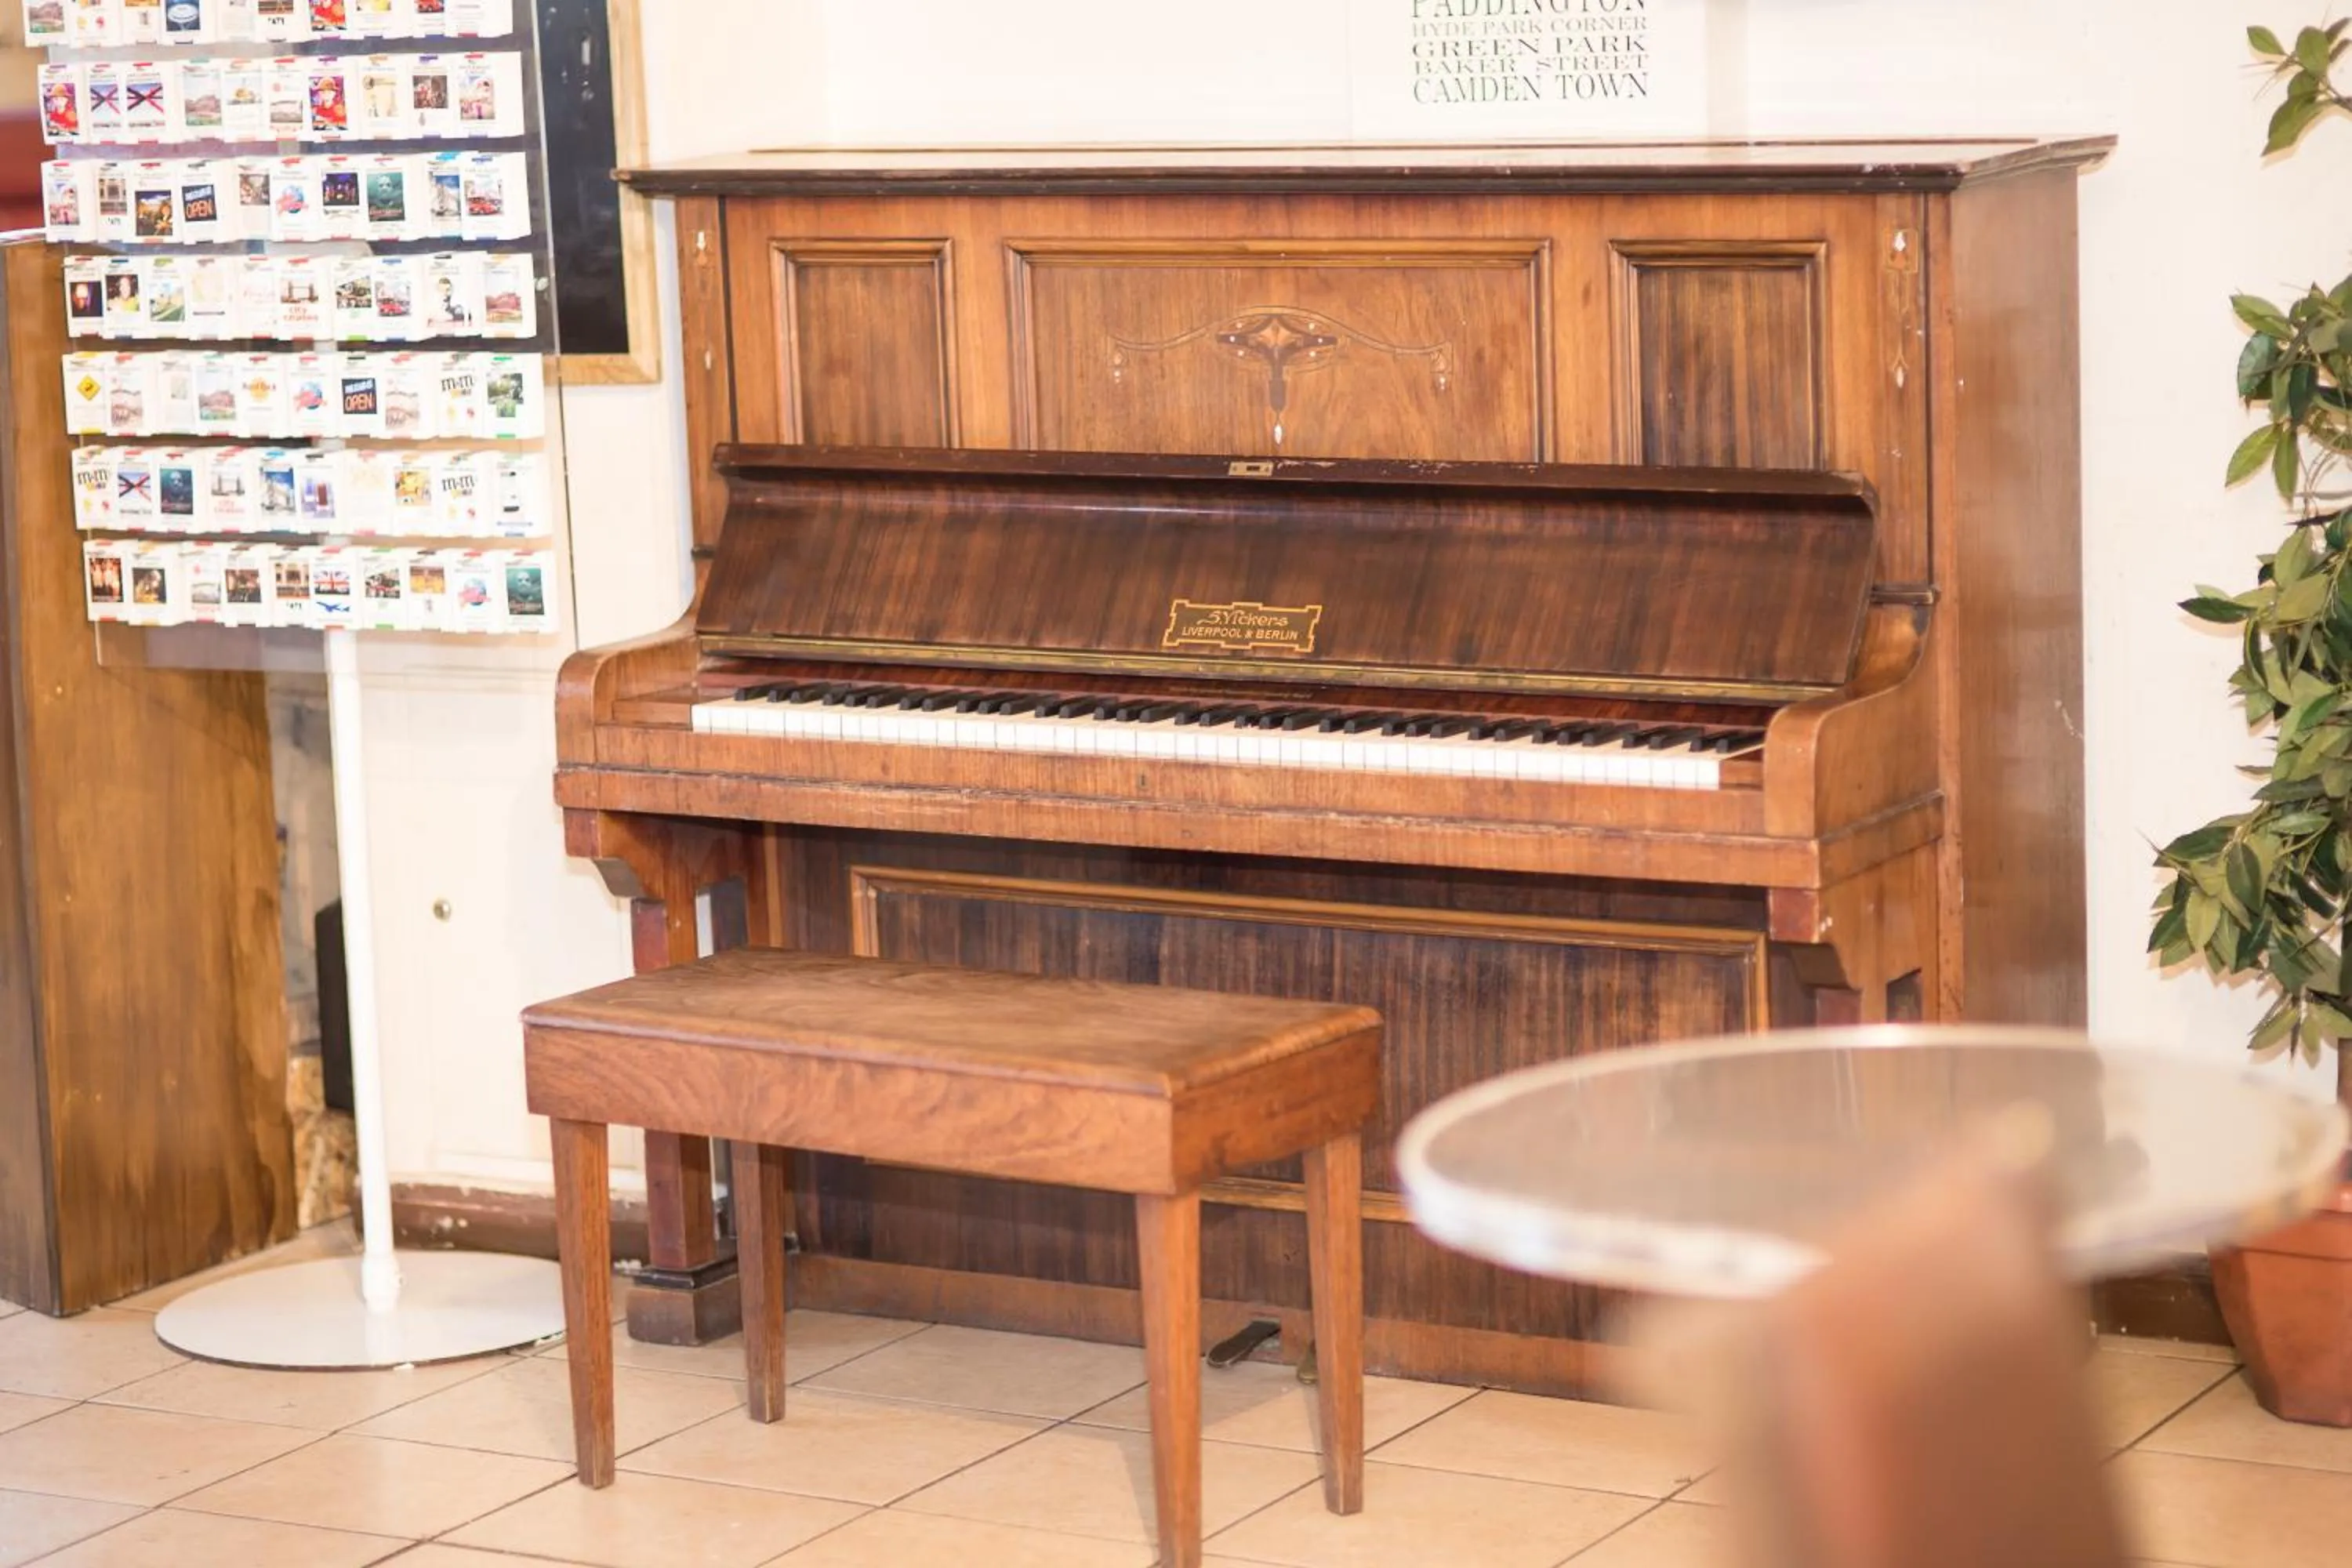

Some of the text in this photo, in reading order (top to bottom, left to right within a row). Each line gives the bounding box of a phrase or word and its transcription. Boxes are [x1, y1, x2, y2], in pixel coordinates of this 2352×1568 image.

[1412, 16, 1646, 38] HYDE PARK CORNER
[1412, 34, 1646, 58] GREEN PARK
[1415, 54, 1649, 74] BAKER STREET
[1414, 72, 1647, 103] CAMDEN TOWN
[344, 392, 373, 412] OPEN
[1181, 626, 1298, 641] LIVERPOOL & BERLIN
